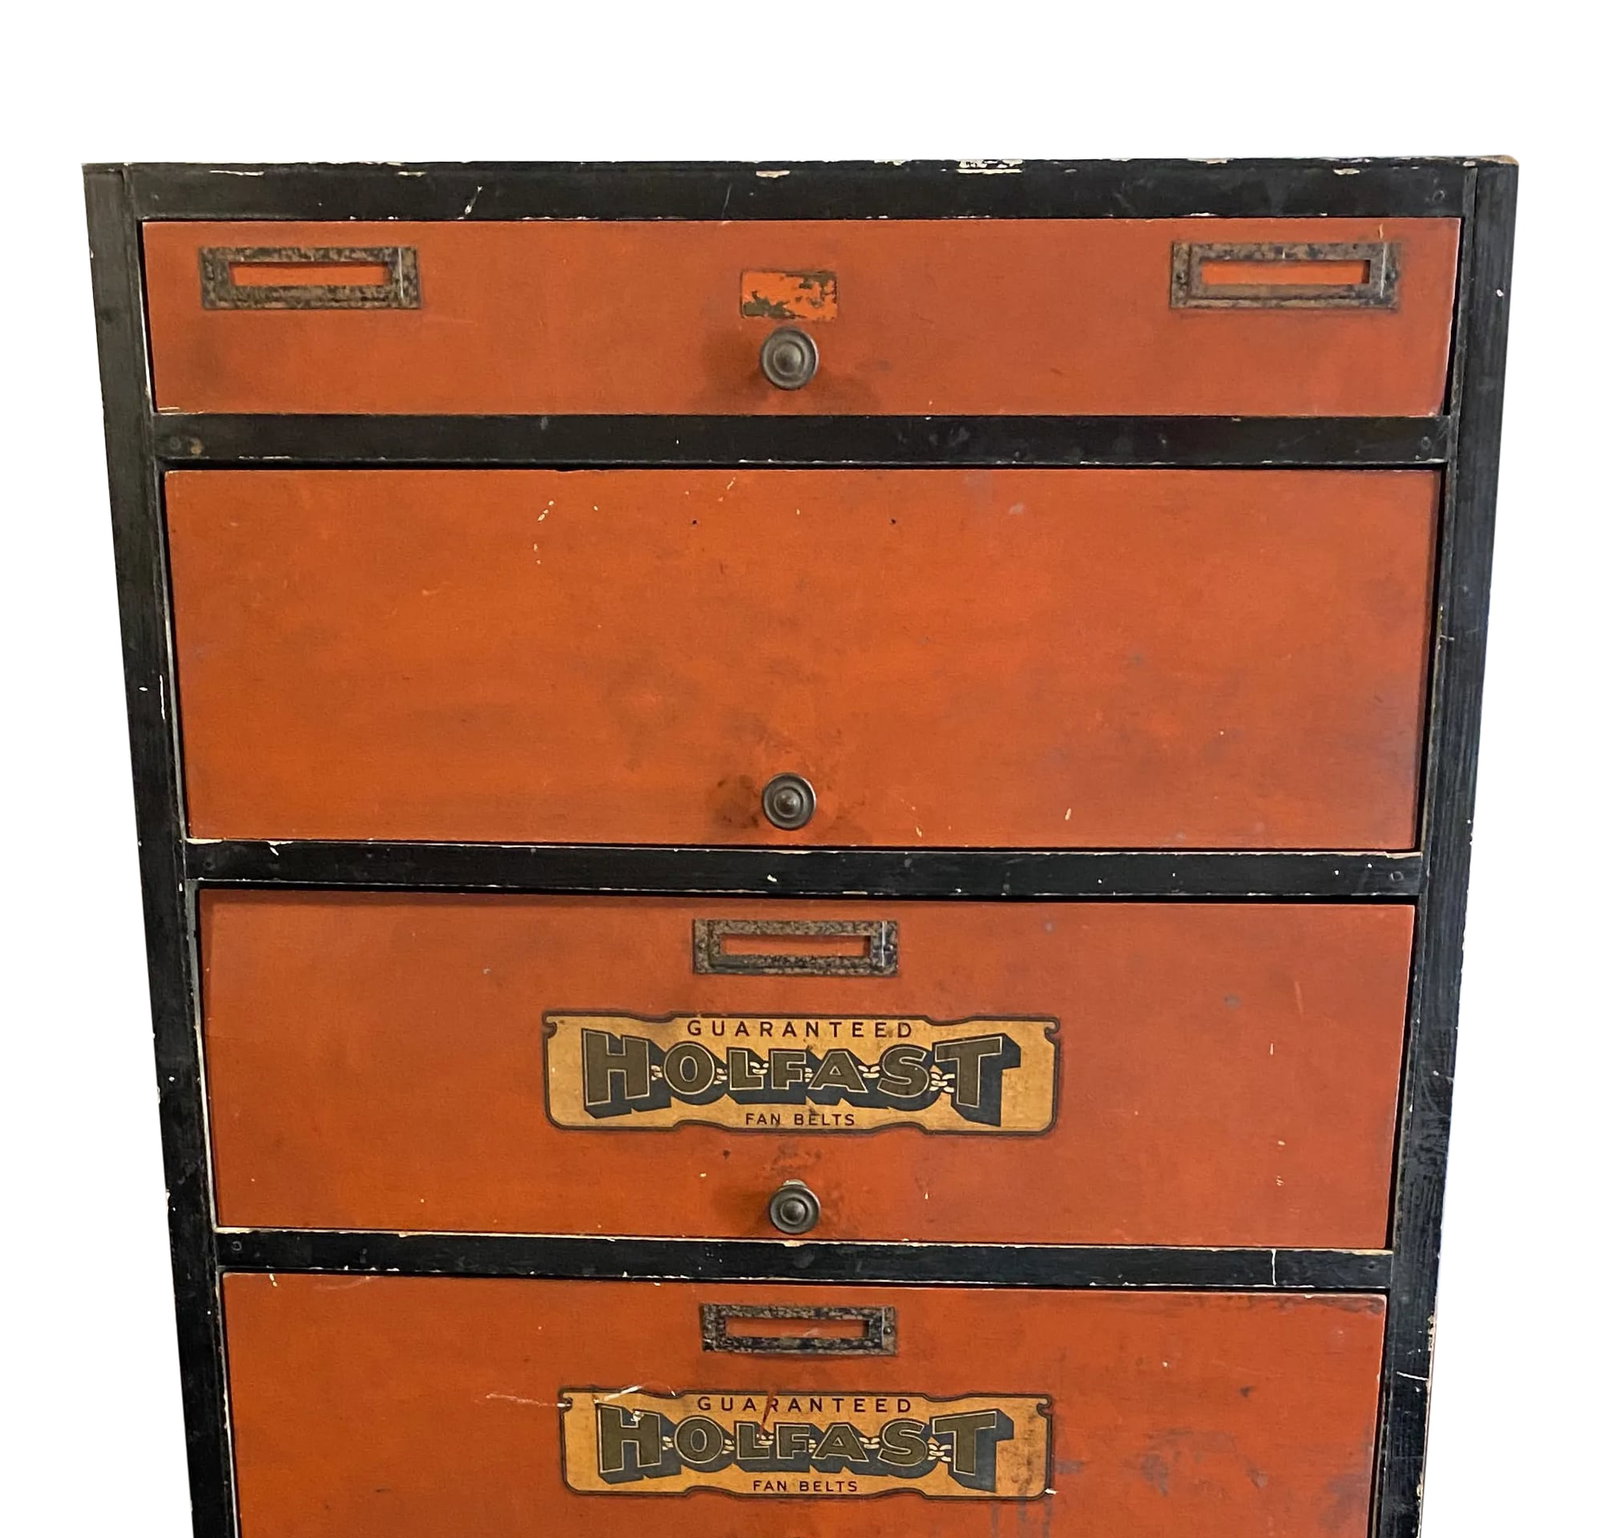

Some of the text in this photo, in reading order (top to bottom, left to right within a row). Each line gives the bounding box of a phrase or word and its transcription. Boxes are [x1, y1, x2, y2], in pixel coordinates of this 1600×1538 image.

[687, 1019, 913, 1038] GUARANTEED
[581, 1028, 1021, 1127] HOLFAST
[745, 1112, 855, 1127] FAN BELTS
[697, 1396, 912, 1413] GUARANTEED
[595, 1402, 1015, 1493] HOLFAST
[752, 1480, 858, 1493] FAN BELTS
